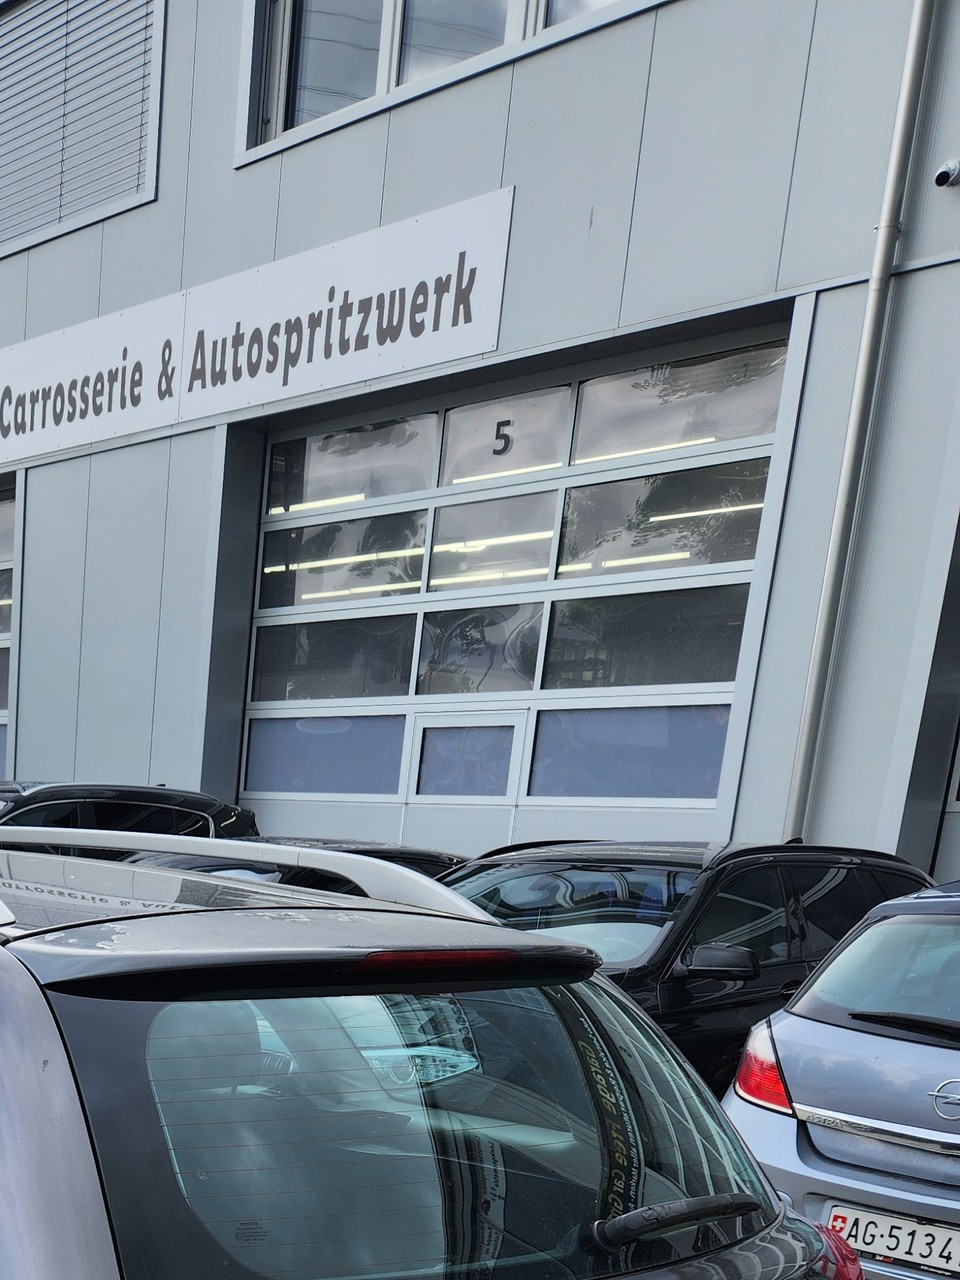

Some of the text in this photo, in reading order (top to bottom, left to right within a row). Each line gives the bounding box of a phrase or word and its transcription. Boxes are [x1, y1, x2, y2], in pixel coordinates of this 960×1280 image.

[0, 346, 143, 439] Carrosserie
[157, 338, 176, 401] &
[187, 250, 477, 393] Autospritzwerk
[492, 419, 511, 456] 5
[805, 1112, 844, 1129] ASTRA
